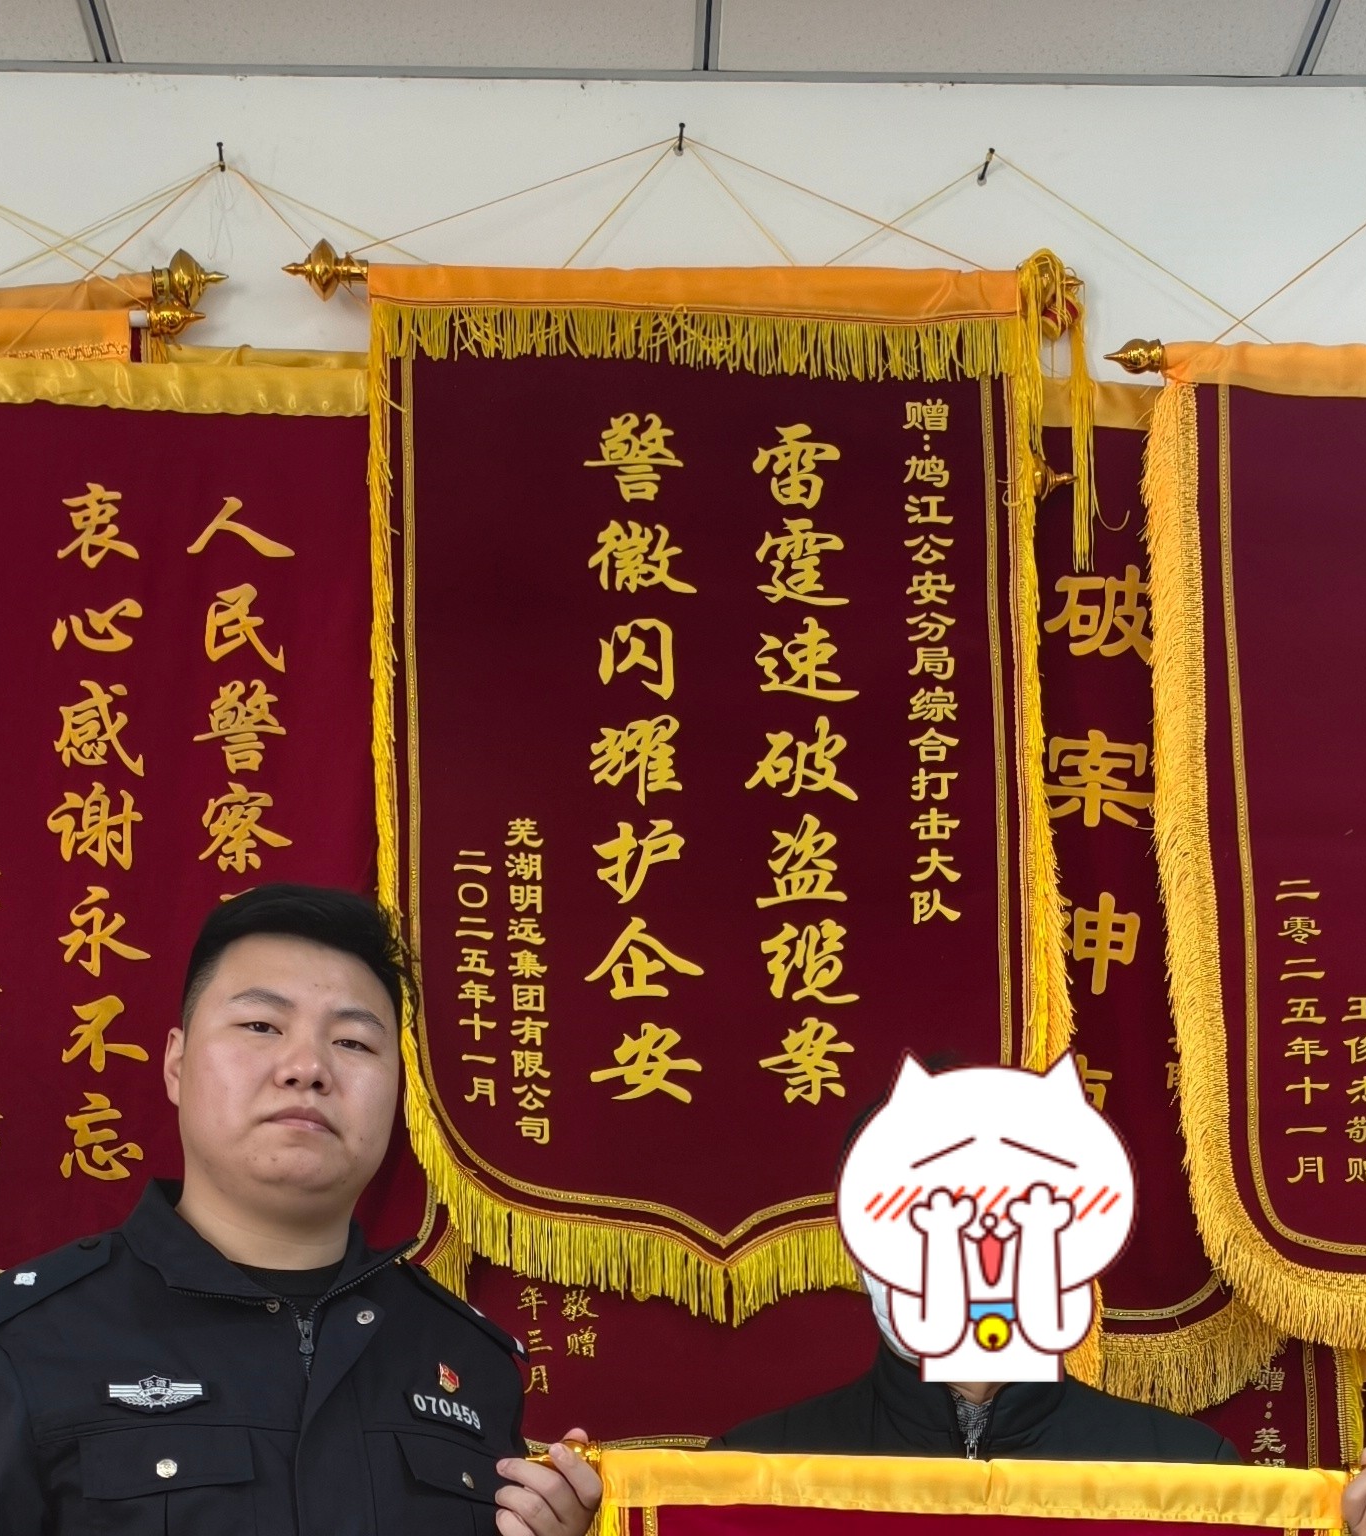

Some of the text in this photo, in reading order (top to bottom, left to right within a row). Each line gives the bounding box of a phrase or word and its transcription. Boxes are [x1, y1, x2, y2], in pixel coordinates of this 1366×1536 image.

[47, 482, 151, 1180] 衷心感谢永不忘
[187, 496, 295, 902] 人民警察
[584, 413, 704, 1103] 警徽闪耀护企安
[745, 424, 860, 1105] 雷霆速破盗缆案
[902, 399, 961, 924] 赠：鸠江公安分局综合打击大队
[504, 817, 551, 1144] 芜湖明远集团有限公司
[1275, 880, 1329, 1183] 二零二五年十一月
[413, 1393, 481, 1431] 070459
[561, 1289, 600, 1358] 敬赠
